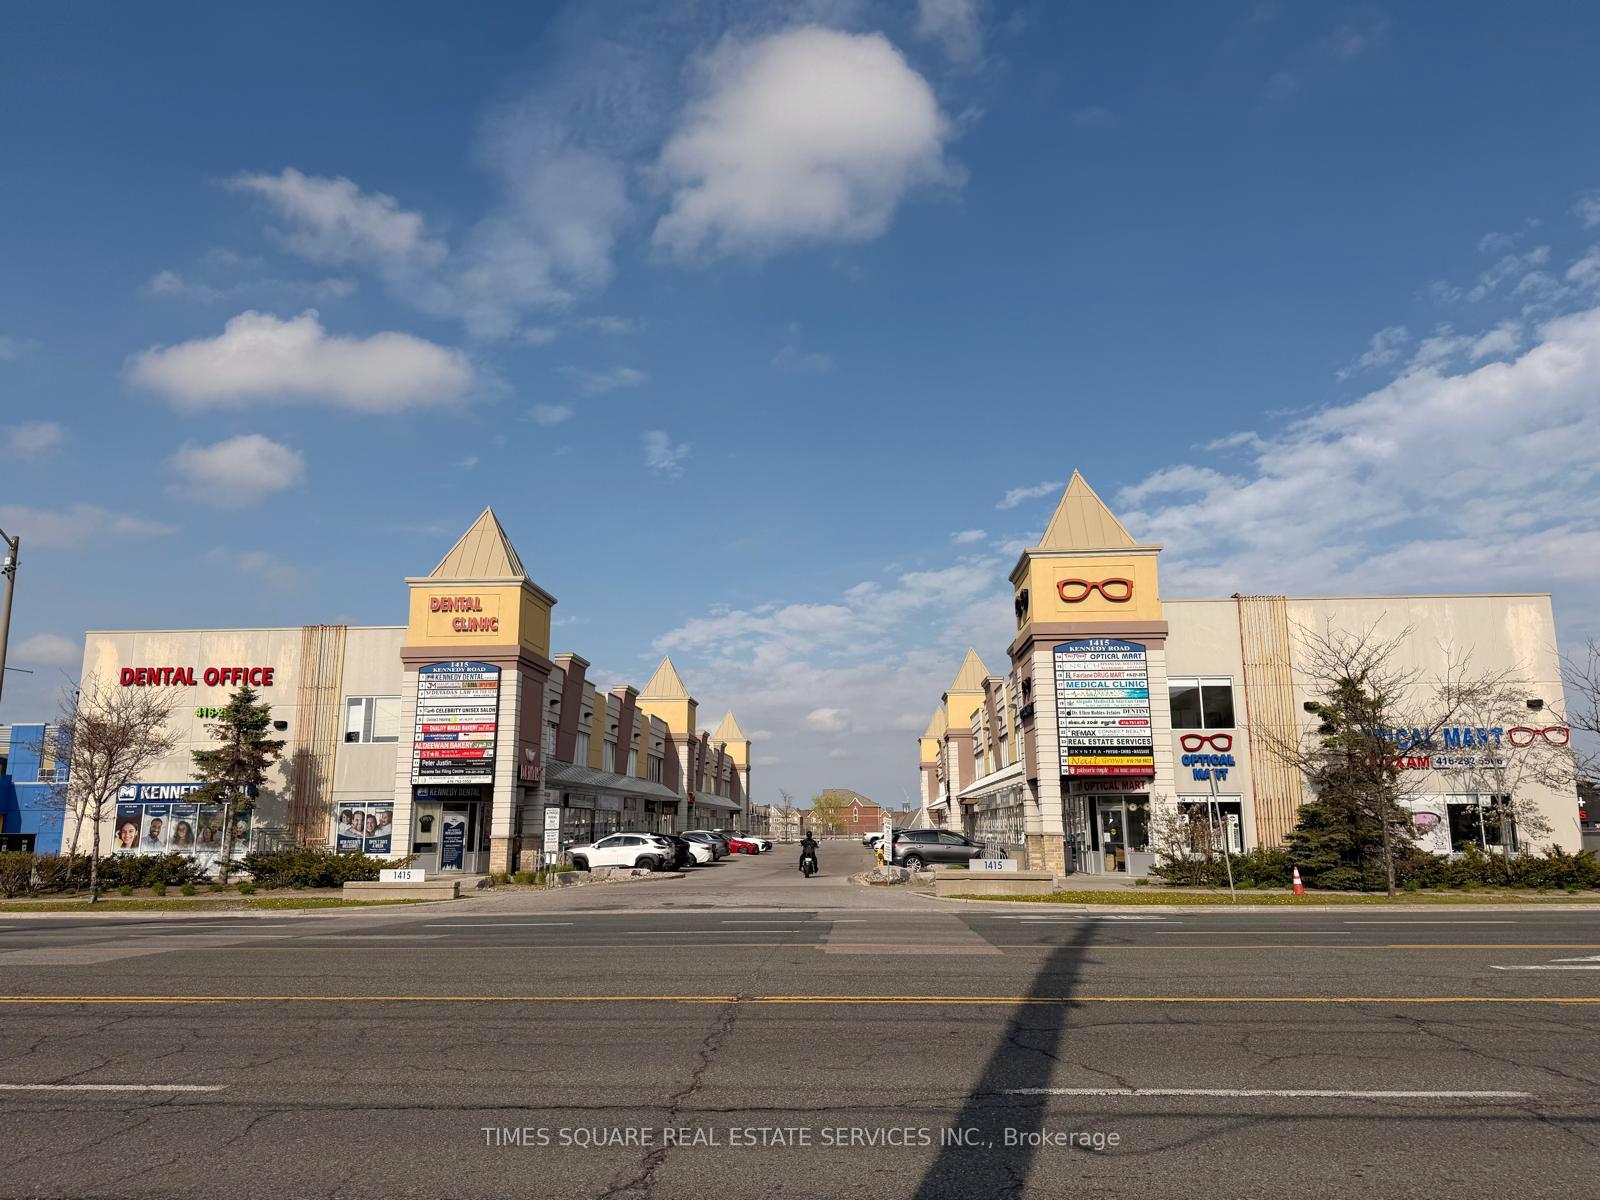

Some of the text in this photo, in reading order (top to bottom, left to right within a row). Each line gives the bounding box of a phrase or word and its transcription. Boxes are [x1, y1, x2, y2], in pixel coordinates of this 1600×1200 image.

[430, 597, 482, 612] DENTAL
[452, 617, 498, 632] CLINIC
[120, 667, 274, 686] DENTAL OFFICE
[1442, 726, 1505, 750] MART
[1182, 754, 1235, 767] OPTICAL
[429, 787, 480, 796] KENNEDY DENTAL
[1084, 781, 1146, 790] OPTICAL MART
[984, 861, 1003, 870] 1415
[394, 871, 411, 880] 1415
